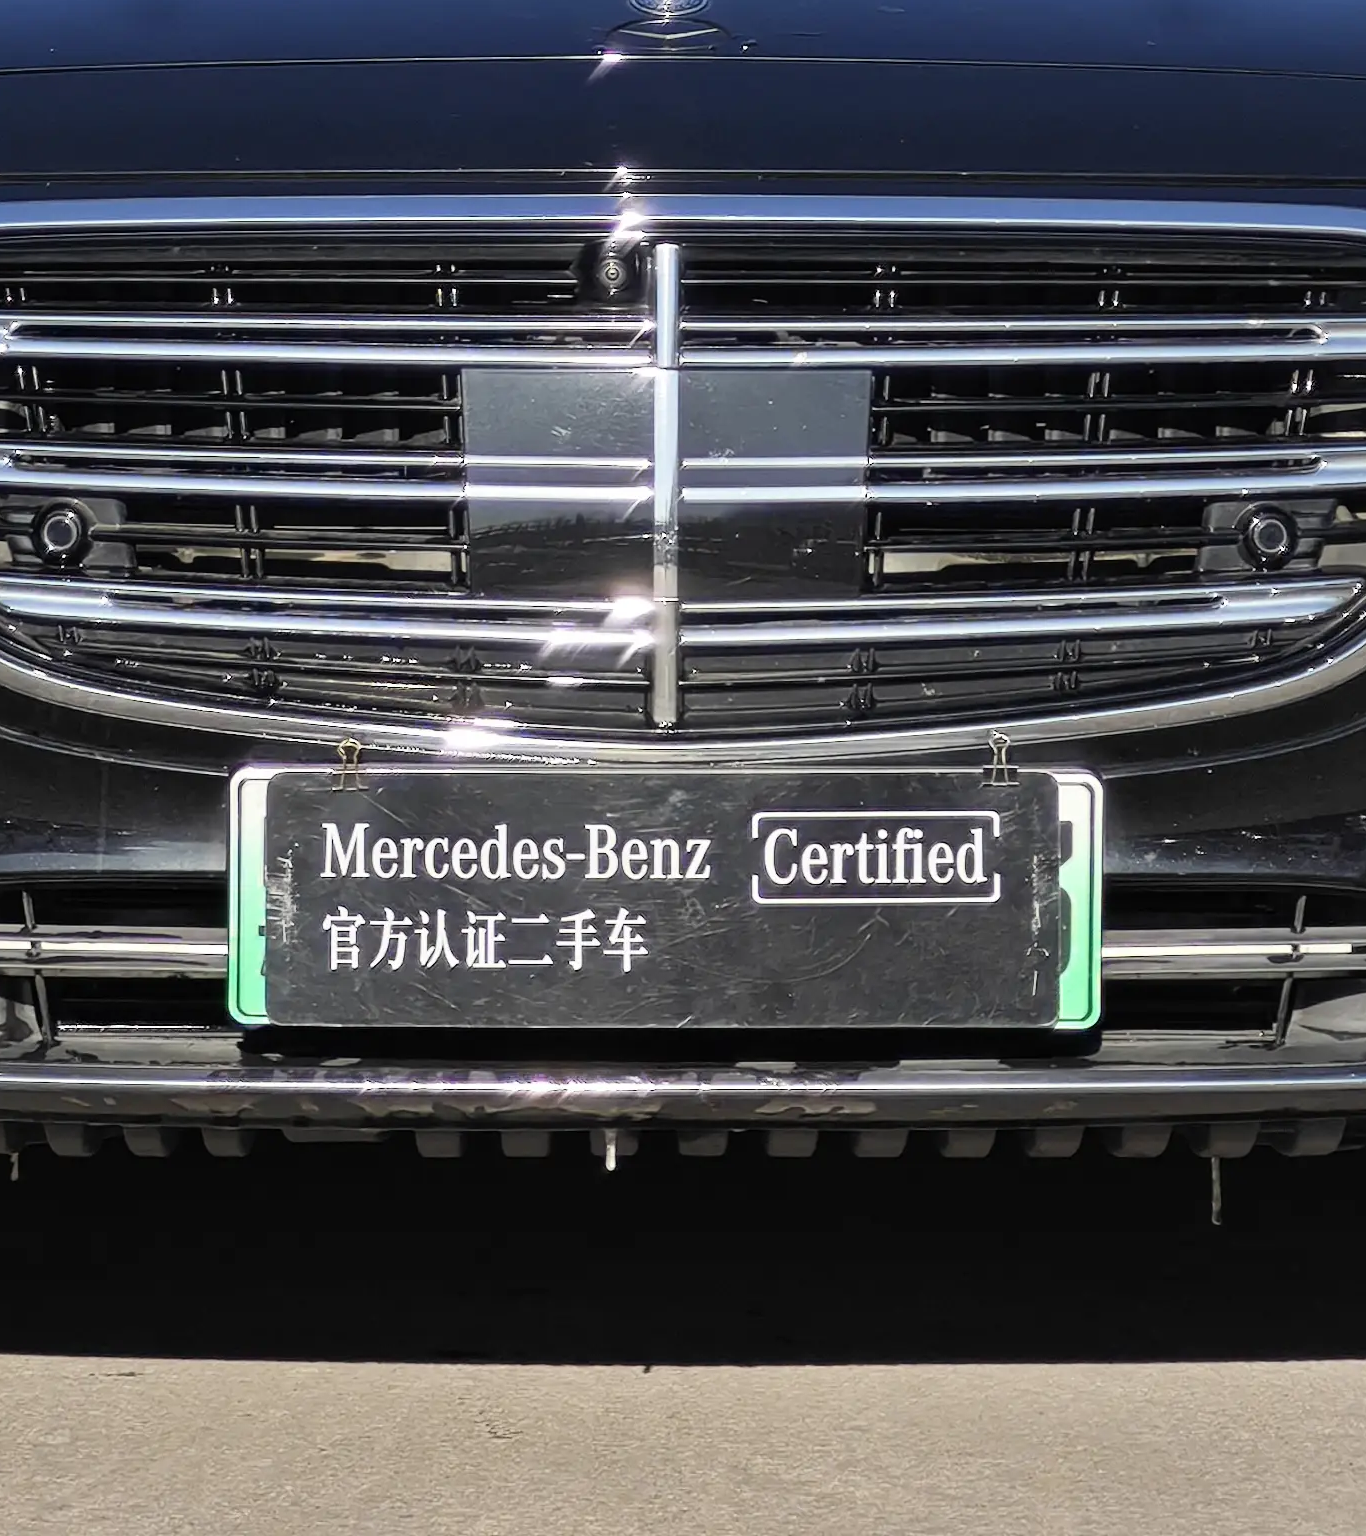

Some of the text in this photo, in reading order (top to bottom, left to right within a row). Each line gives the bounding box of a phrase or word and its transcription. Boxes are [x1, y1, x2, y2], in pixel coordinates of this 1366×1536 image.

[319, 821, 988, 885] Mercedes-Benz Certified
[321, 905, 650, 973] 官方认证二手车
